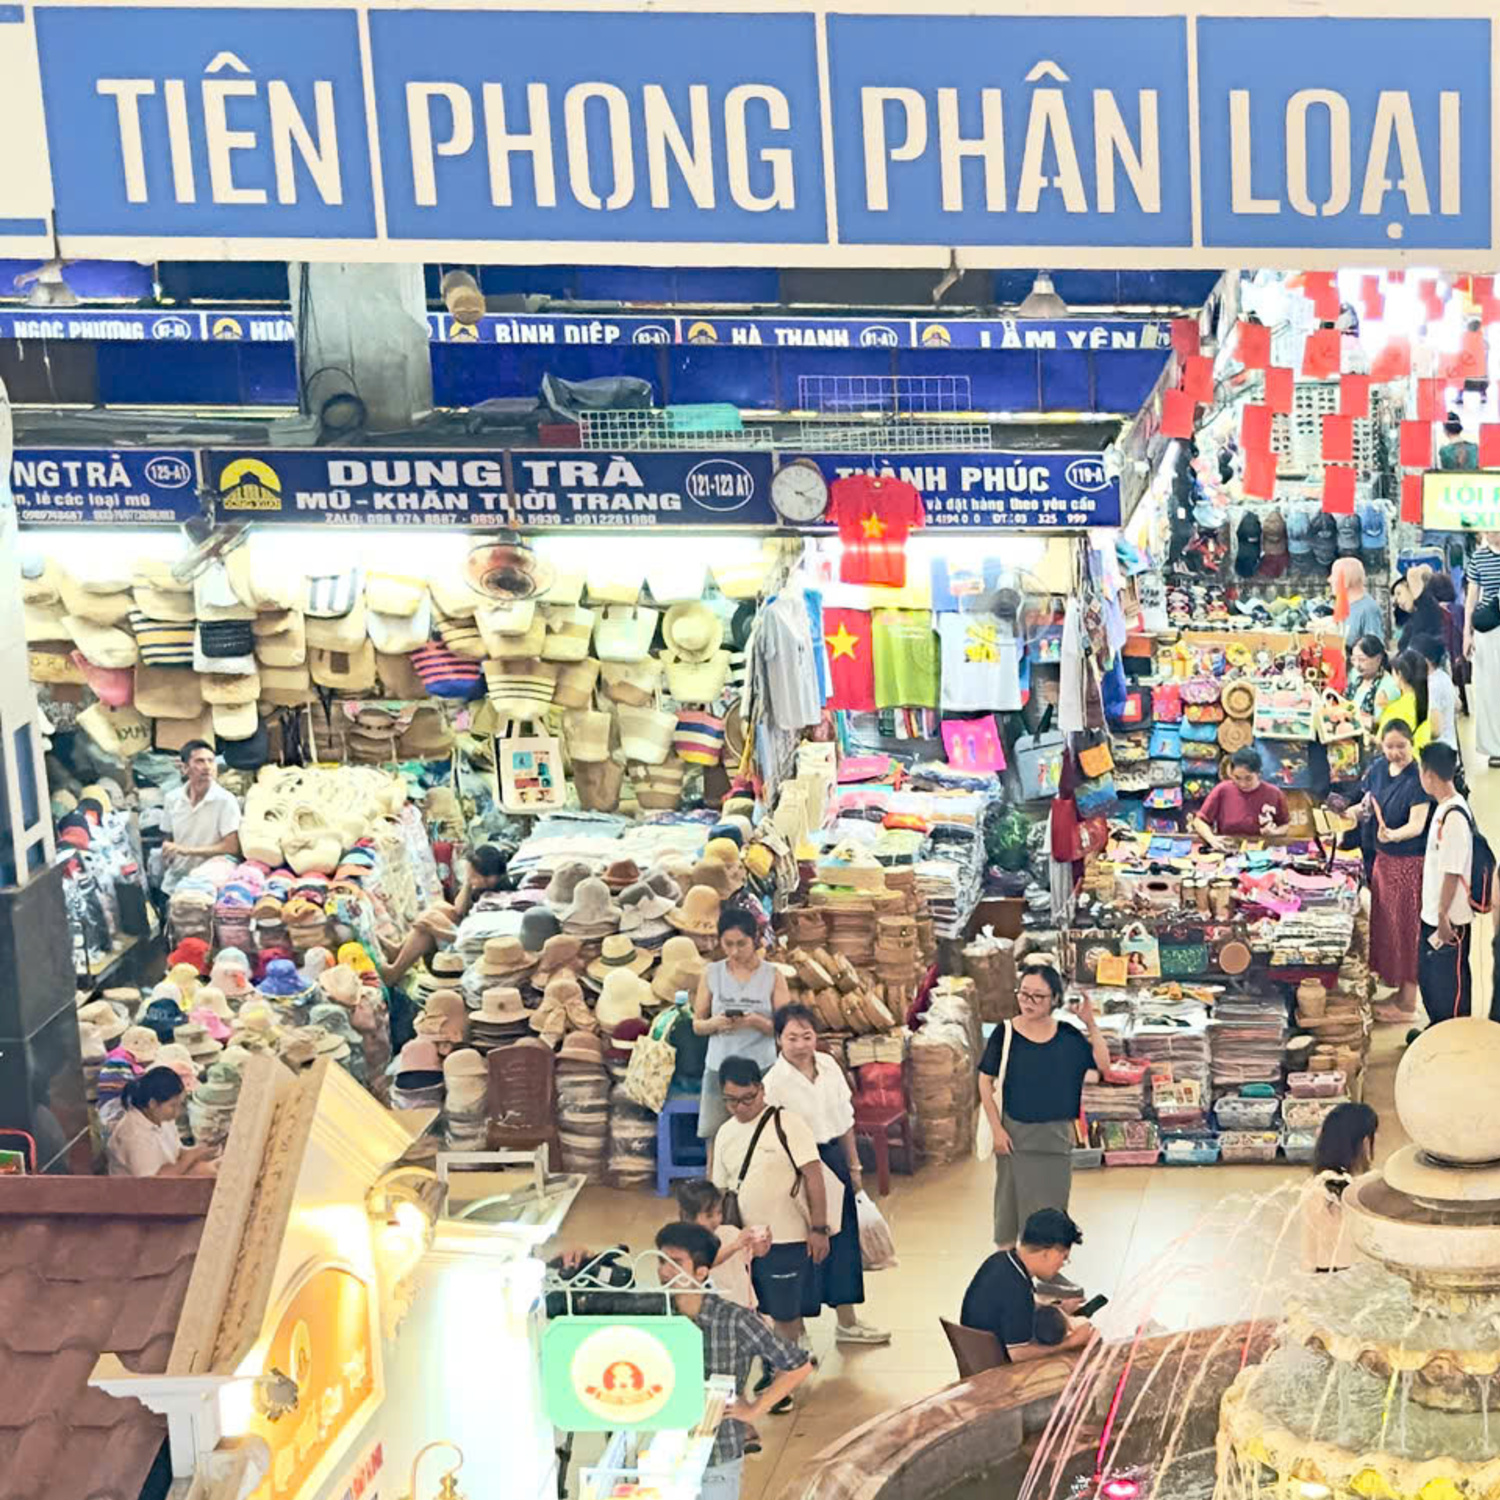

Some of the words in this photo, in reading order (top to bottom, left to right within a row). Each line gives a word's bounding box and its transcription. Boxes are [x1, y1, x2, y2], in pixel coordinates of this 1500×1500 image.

[97, 52, 342, 206] TIÊN
[405, 82, 793, 213] PHONG
[865, 61, 1161, 214] PHÂN
[1230, 89, 1460, 239] LOẠI
[732, 323, 762, 346] HÀ
[774, 328, 849, 347] THANH
[62, 454, 131, 488] TRÀ
[327, 460, 502, 487] DUNG
[522, 455, 643, 487] TRÀ
[836, 460, 946, 490] TÀNH
[961, 459, 1050, 492] PHÚC
[1072, 468, 1105, 484] 119-A
[374, 489, 468, 510] KHĂN
[567, 493, 682, 511] TRANG
[1010, 498, 1038, 511] theo
